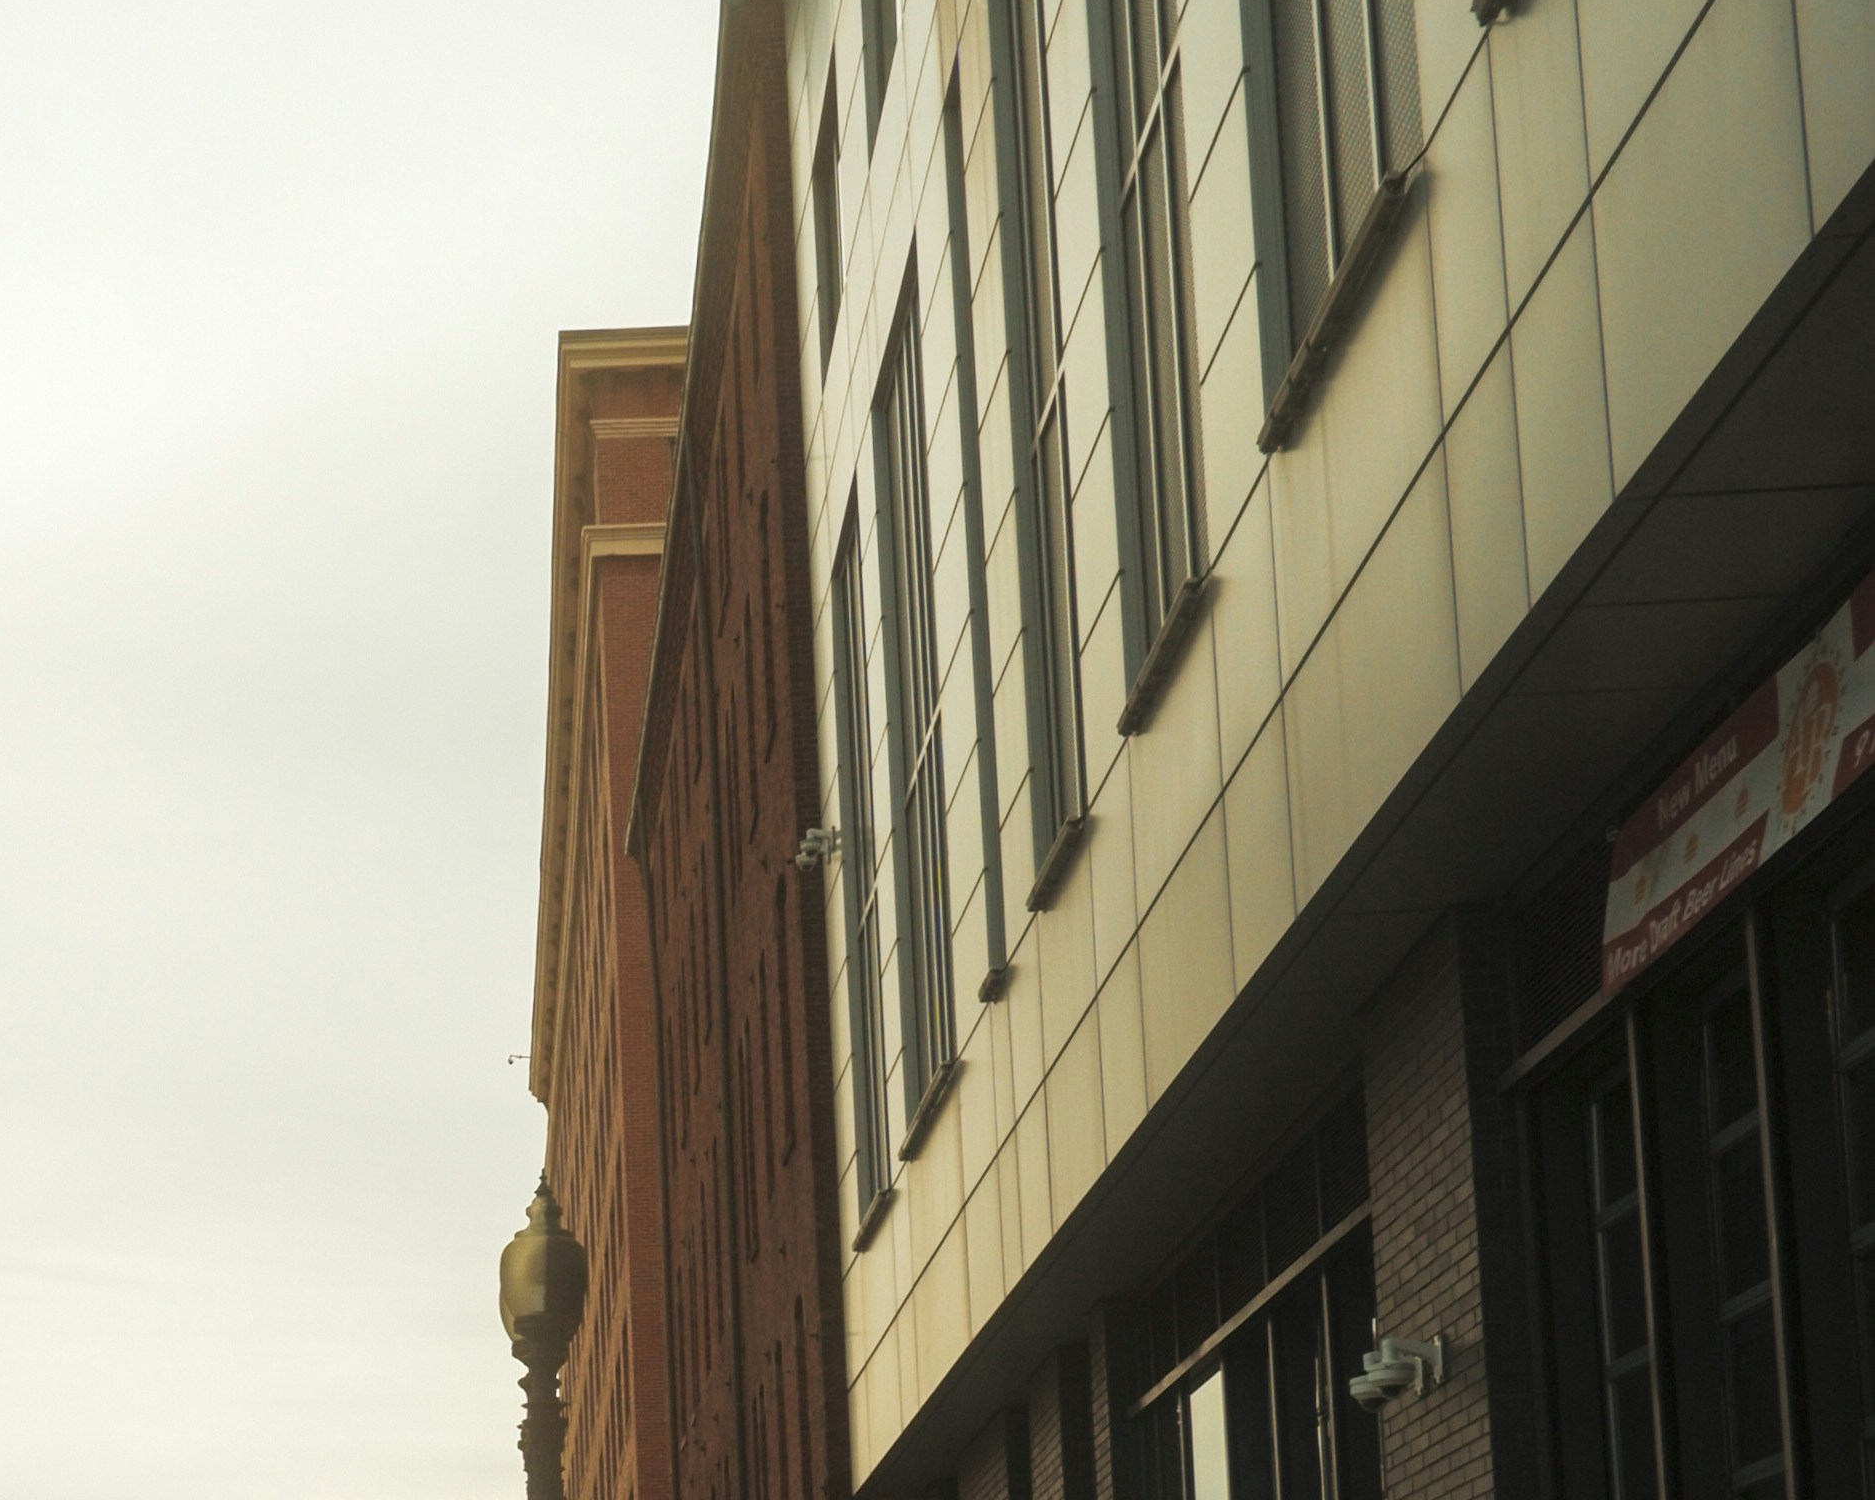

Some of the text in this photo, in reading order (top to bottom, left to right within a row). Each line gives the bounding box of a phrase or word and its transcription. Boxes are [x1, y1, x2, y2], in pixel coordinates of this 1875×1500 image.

[1658, 734, 1737, 831] New Menu
[1606, 836, 1758, 986] More Draft Beer Lines
